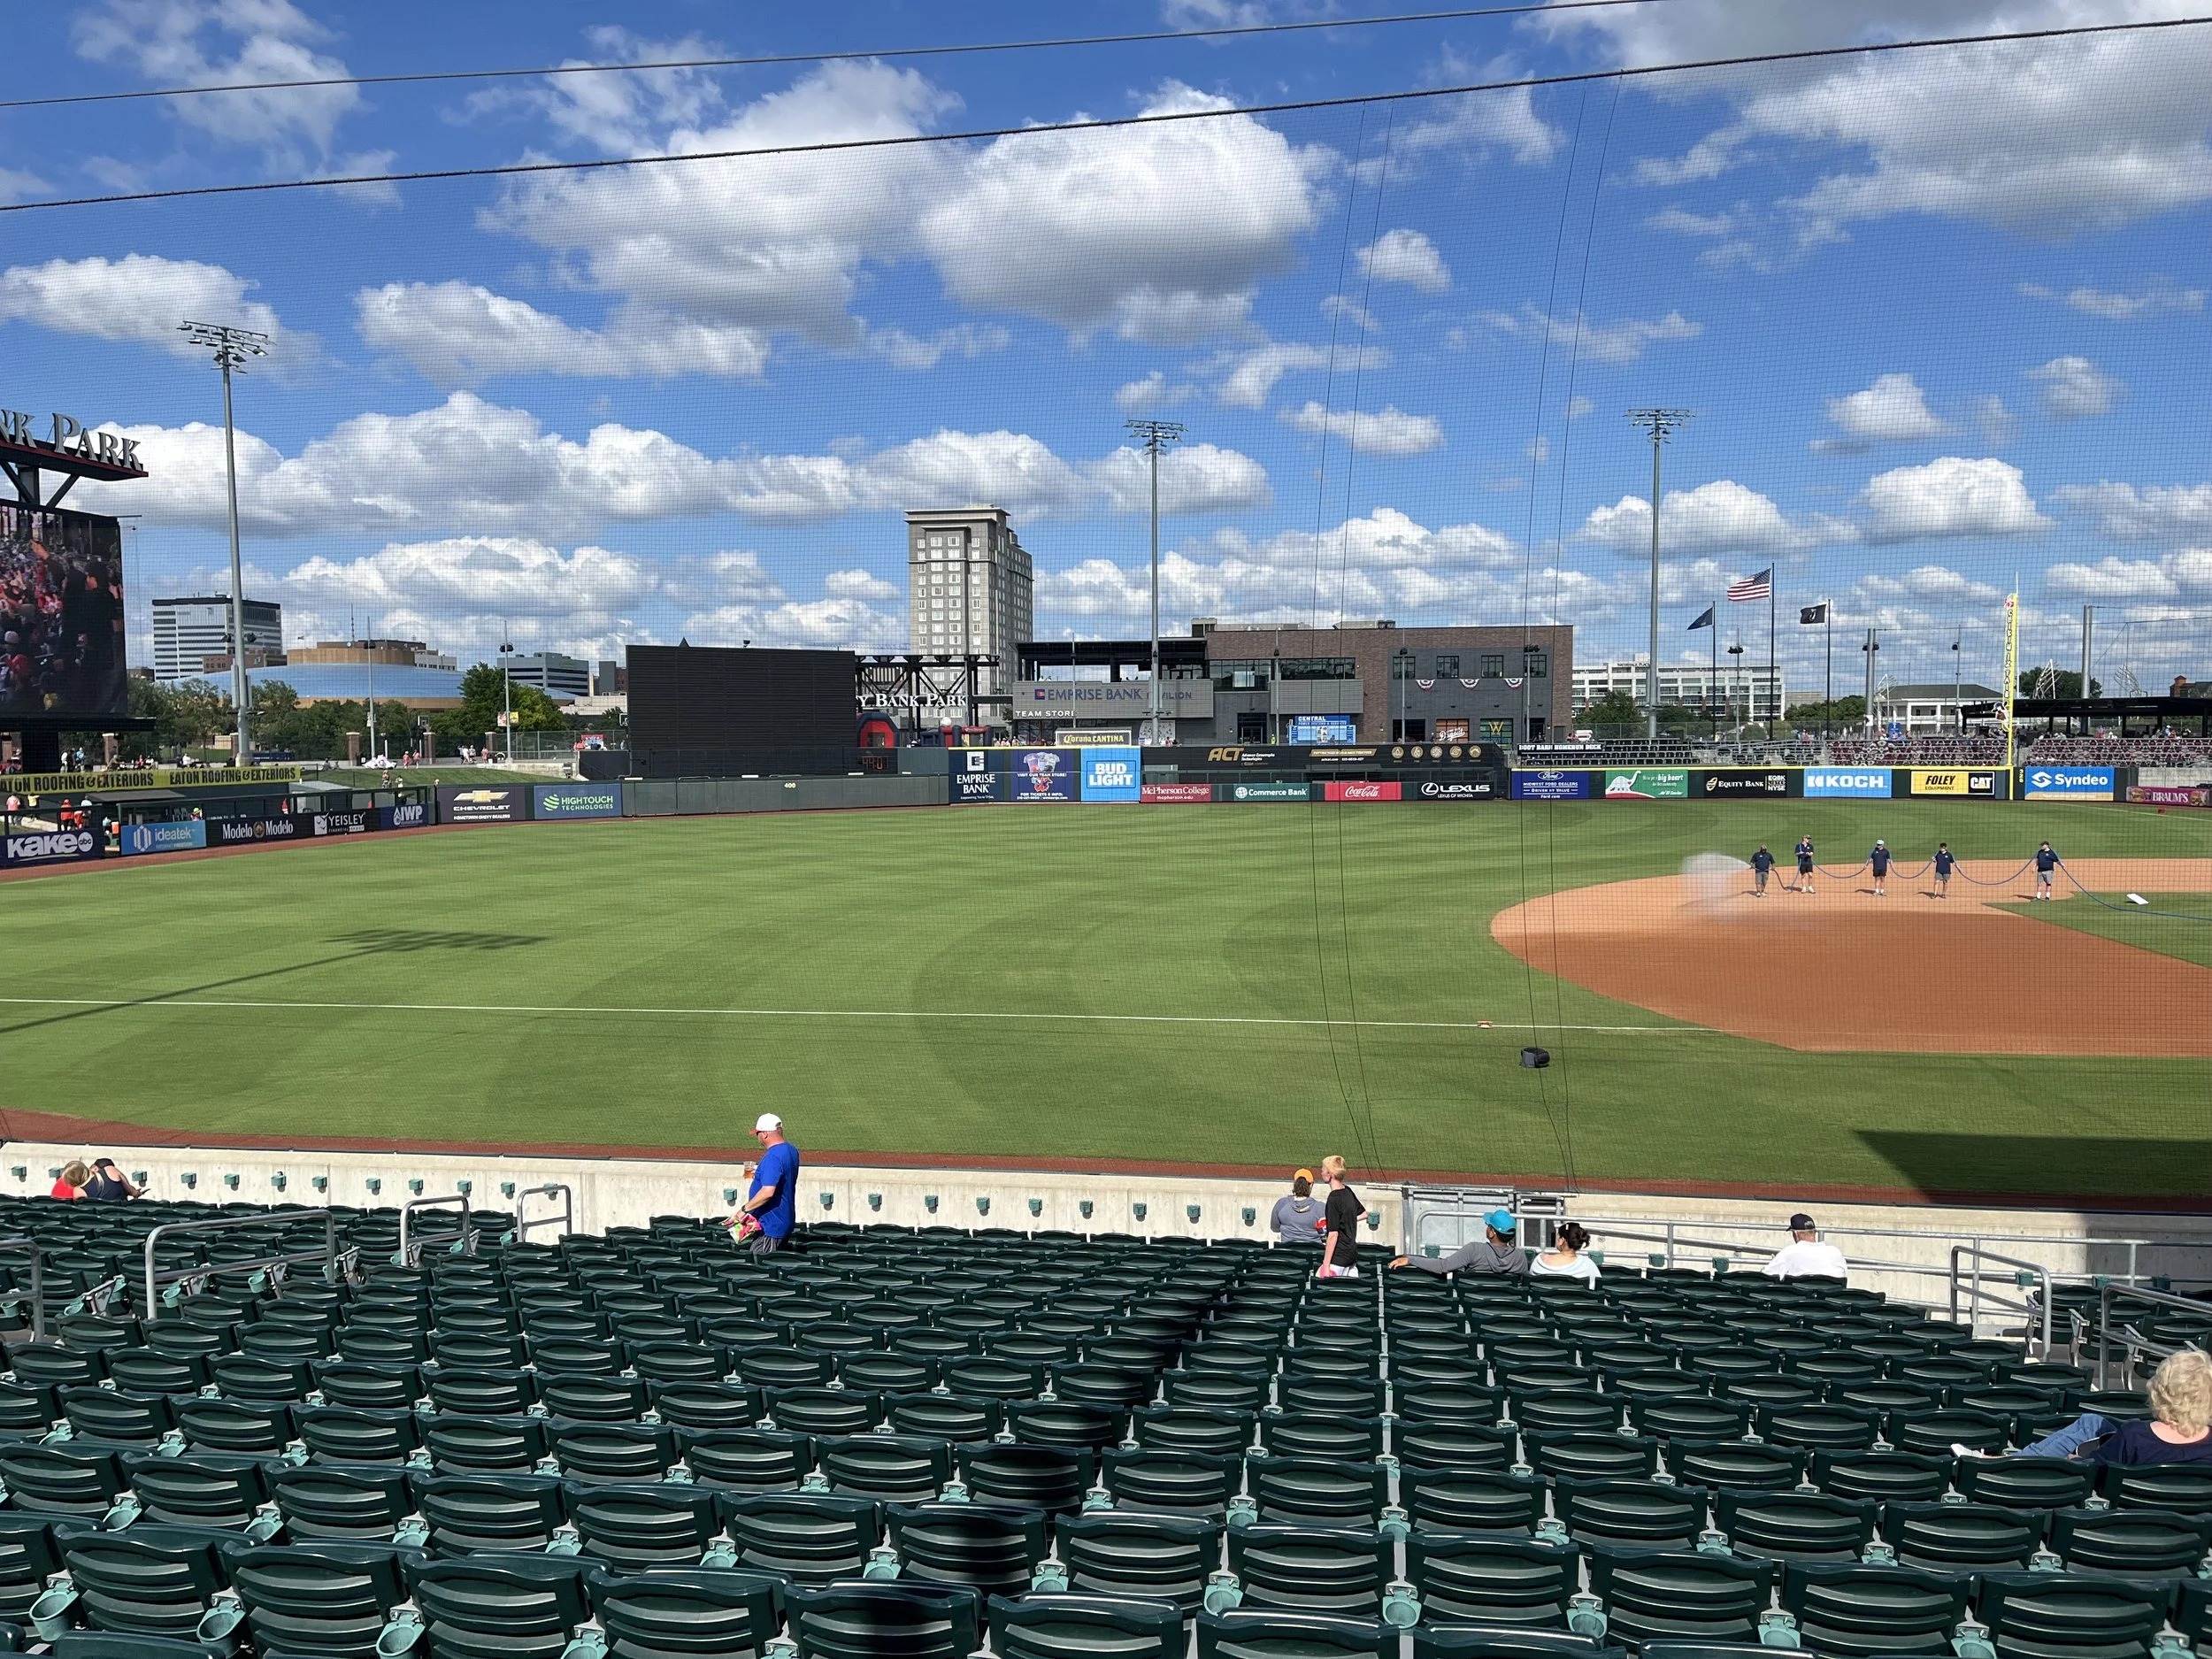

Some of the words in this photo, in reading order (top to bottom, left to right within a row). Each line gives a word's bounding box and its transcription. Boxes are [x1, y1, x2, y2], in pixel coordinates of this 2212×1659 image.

[52, 412, 143, 472] PARK
[875, 693, 920, 707] BANK
[926, 693, 966, 707] PARK
[1048, 688, 1102, 701] EMPRISE
[1106, 688, 1142, 700] BANK
[1064, 734, 1092, 743] Corona
[1208, 747, 1244, 761] ACT
[1094, 763, 1127, 774] BUD
[35, 774, 85, 791] ROOFING
[87, 775, 96, 787] &
[97, 772, 154, 788] EXTERIORS
[170, 772, 200, 786] EATON
[202, 770, 242, 784] ROOFING
[242, 771, 251, 780] &
[251, 767, 296, 781] EXTERIORS
[956, 773, 996, 784] EMPRISE
[1089, 774, 1133, 786] LIGHT
[1825, 775, 1884, 788] KOCH
[1925, 775, 1956, 786] FOLEY
[1970, 777, 1993, 789] CAT
[2055, 773, 2108, 788] Syndeo
[963, 784, 989, 794] BANK
[1183, 787, 1210, 796] College
[1287, 787, 1307, 796] Bank
[401, 805, 423, 821] IWP
[328, 813, 365, 827] YEISLEY
[155, 826, 191, 841] ideatek
[222, 823, 253, 840] Modelo
[265, 819, 294, 836] Modelo
